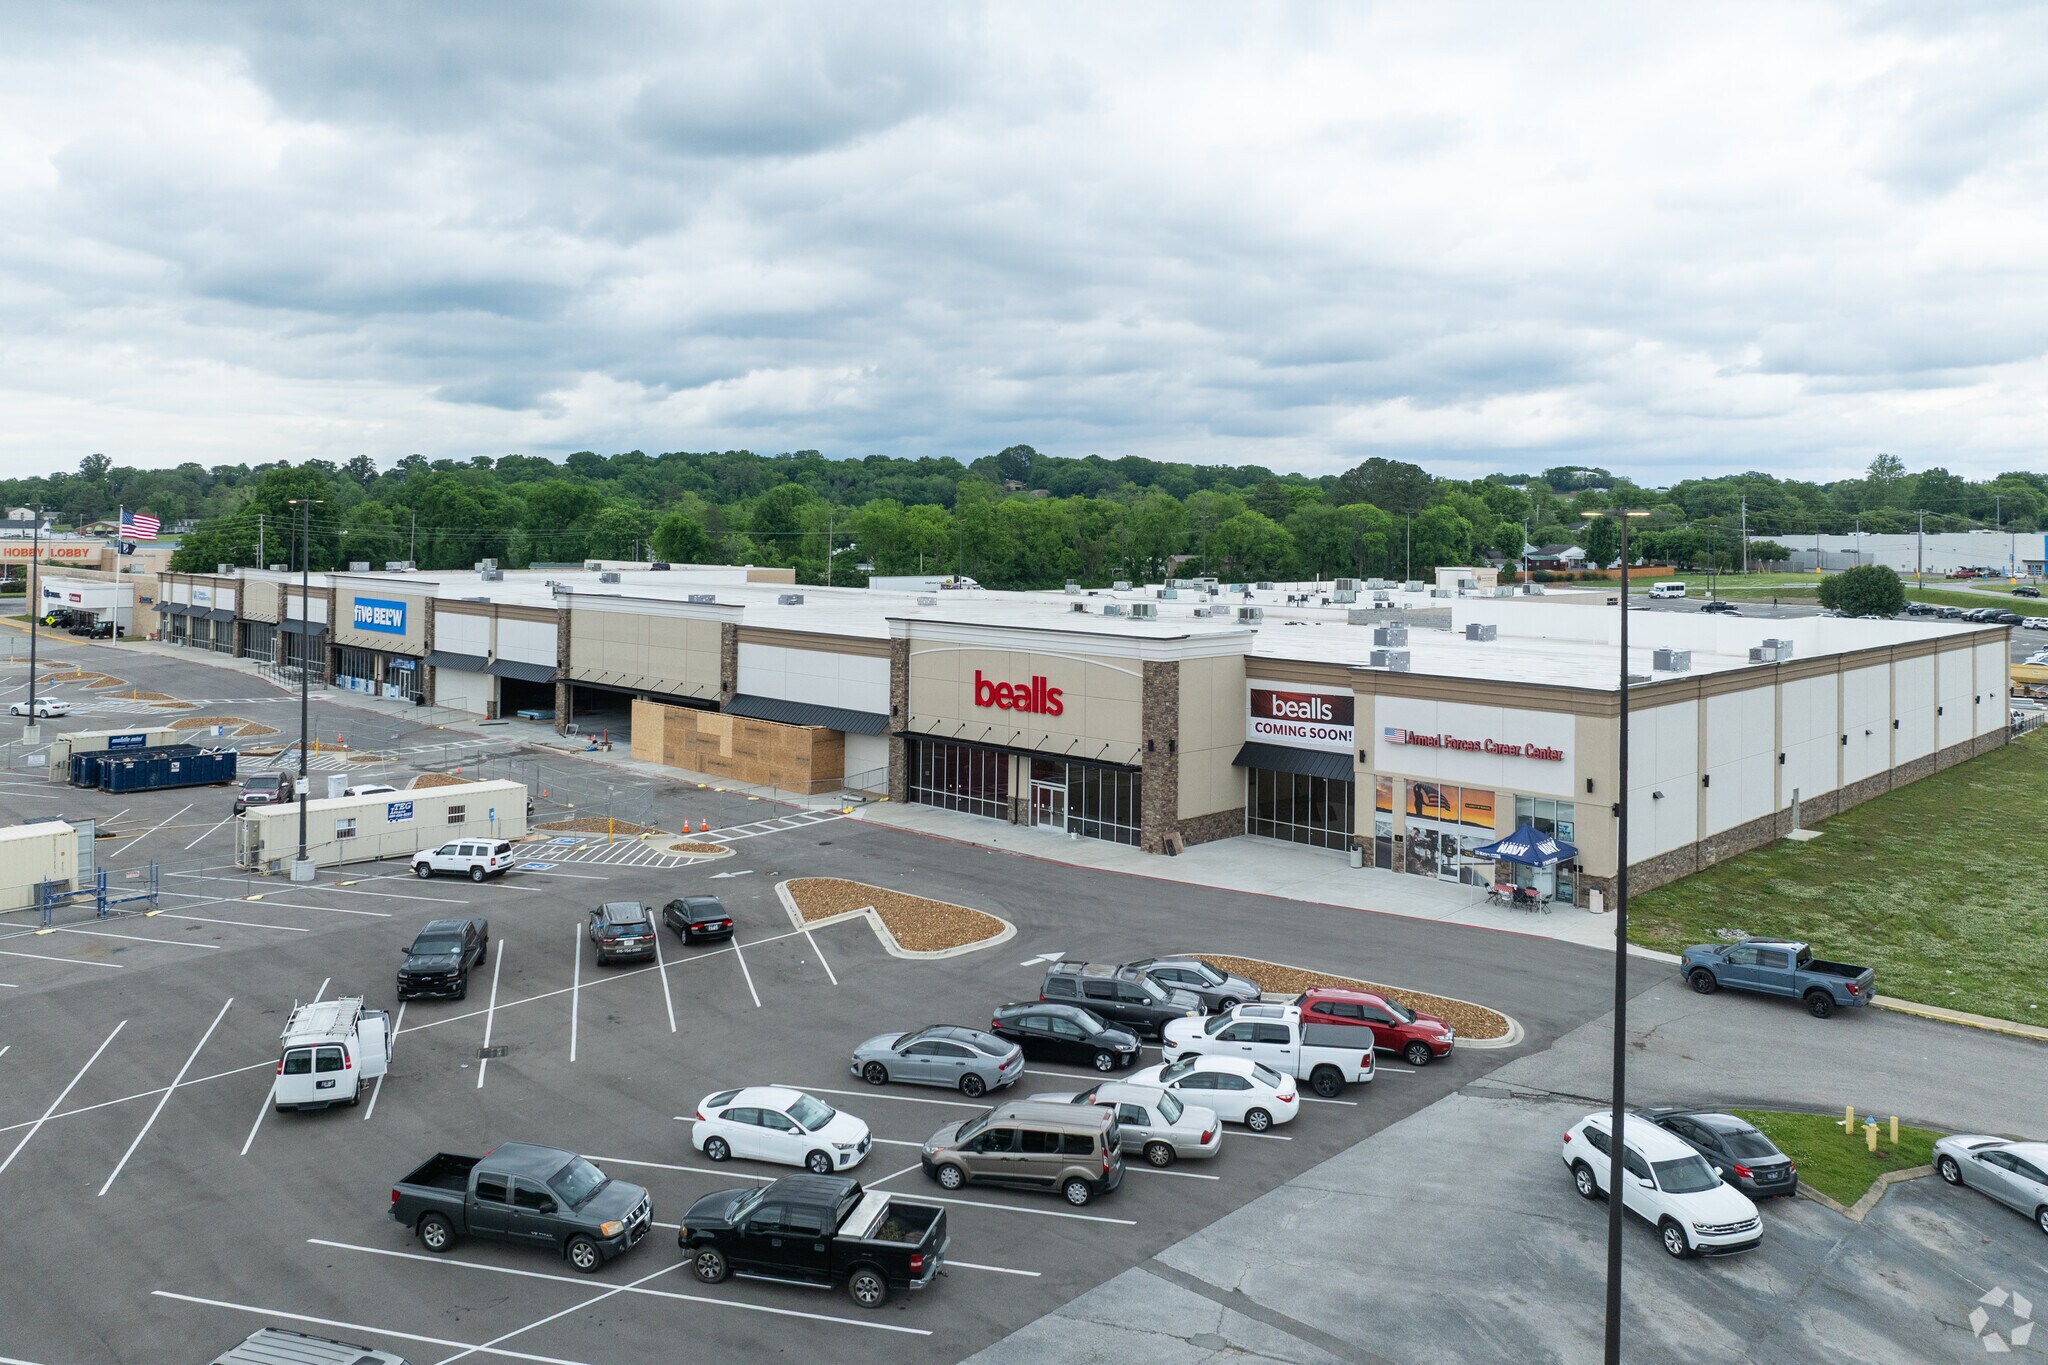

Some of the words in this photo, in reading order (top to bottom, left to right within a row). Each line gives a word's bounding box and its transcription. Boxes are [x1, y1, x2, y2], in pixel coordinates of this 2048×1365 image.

[4, 548, 43, 557] HOBBY
[50, 548, 89, 557] LOBBY
[354, 605, 372, 623] five
[975, 670, 1063, 716] bealls
[1272, 694, 1333, 720] bealls
[1255, 722, 1307, 738] COMING
[1309, 727, 1352, 742] SOON!
[1408, 731, 1441, 748] Armed
[1443, 735, 1480, 752] Forces
[1483, 738, 1521, 756] Career
[1524, 743, 1563, 761] Center
[1496, 843, 1529, 856] NAVY
[1537, 838, 1560, 855] NAVY
